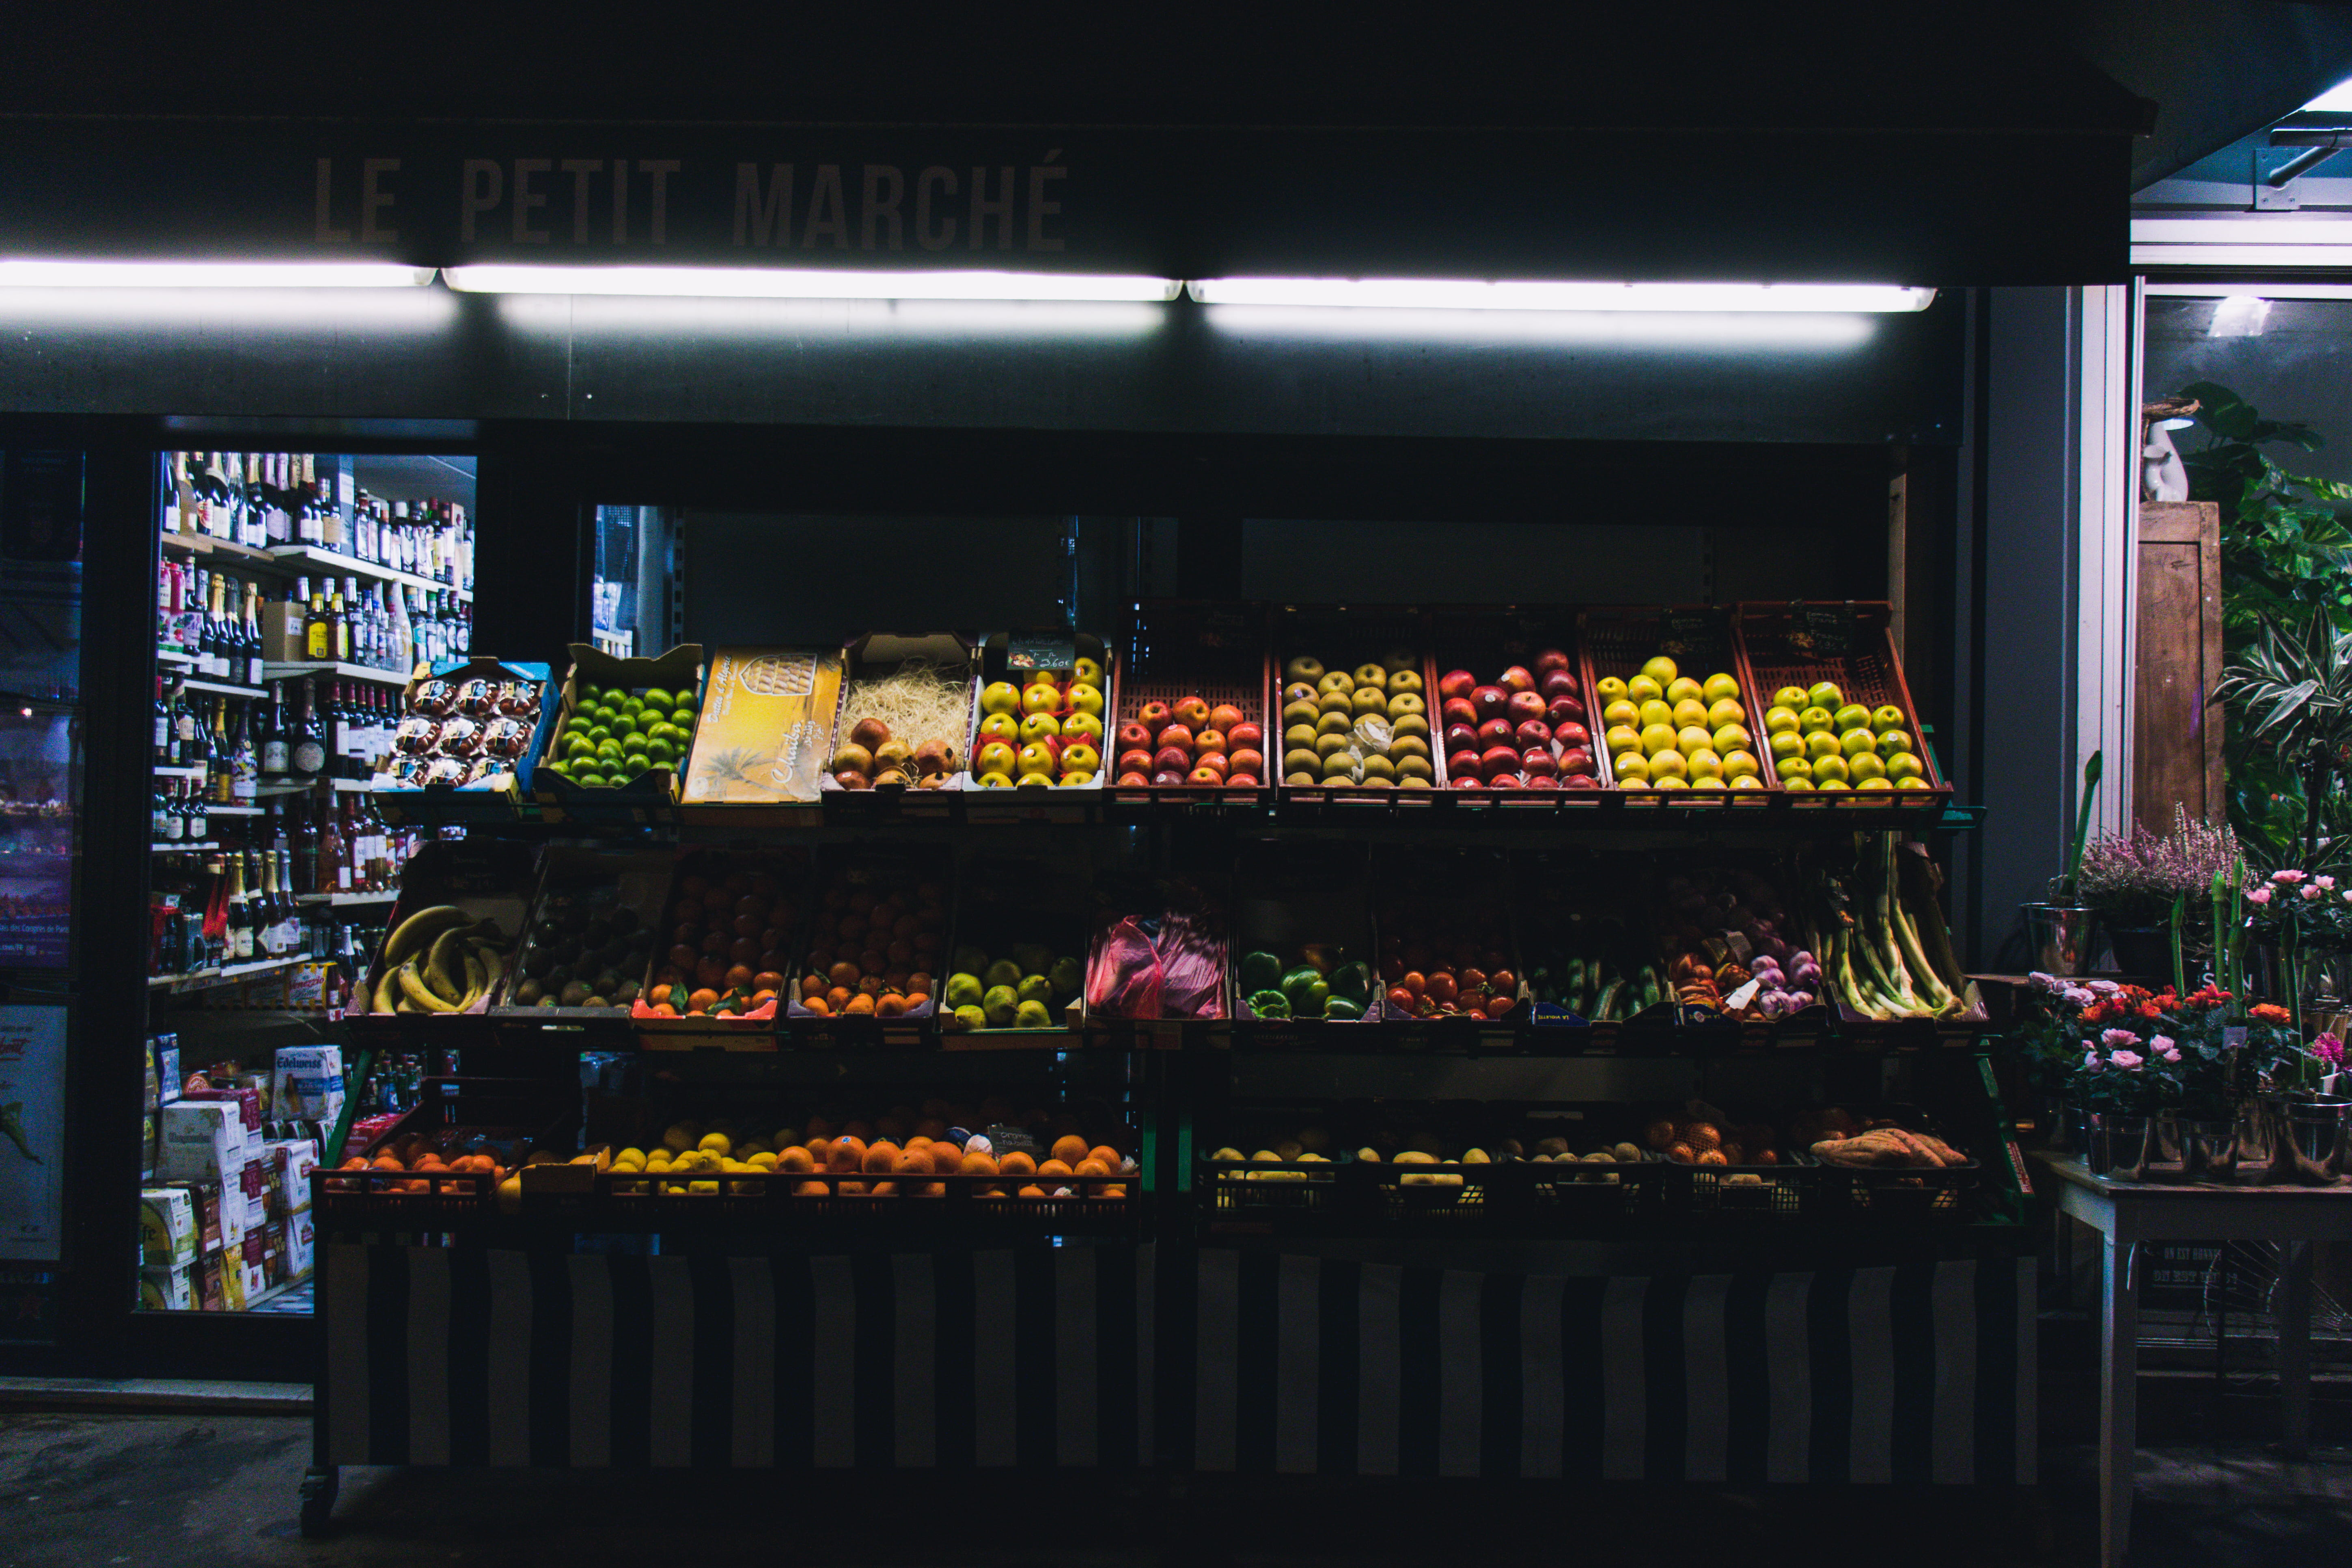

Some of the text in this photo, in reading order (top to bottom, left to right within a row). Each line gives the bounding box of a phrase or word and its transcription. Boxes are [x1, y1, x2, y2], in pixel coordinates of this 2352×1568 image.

[315, 149, 1068, 252] LE PETIT MARCHÉ
[276, 1057, 322, 1068] Edelweiss
